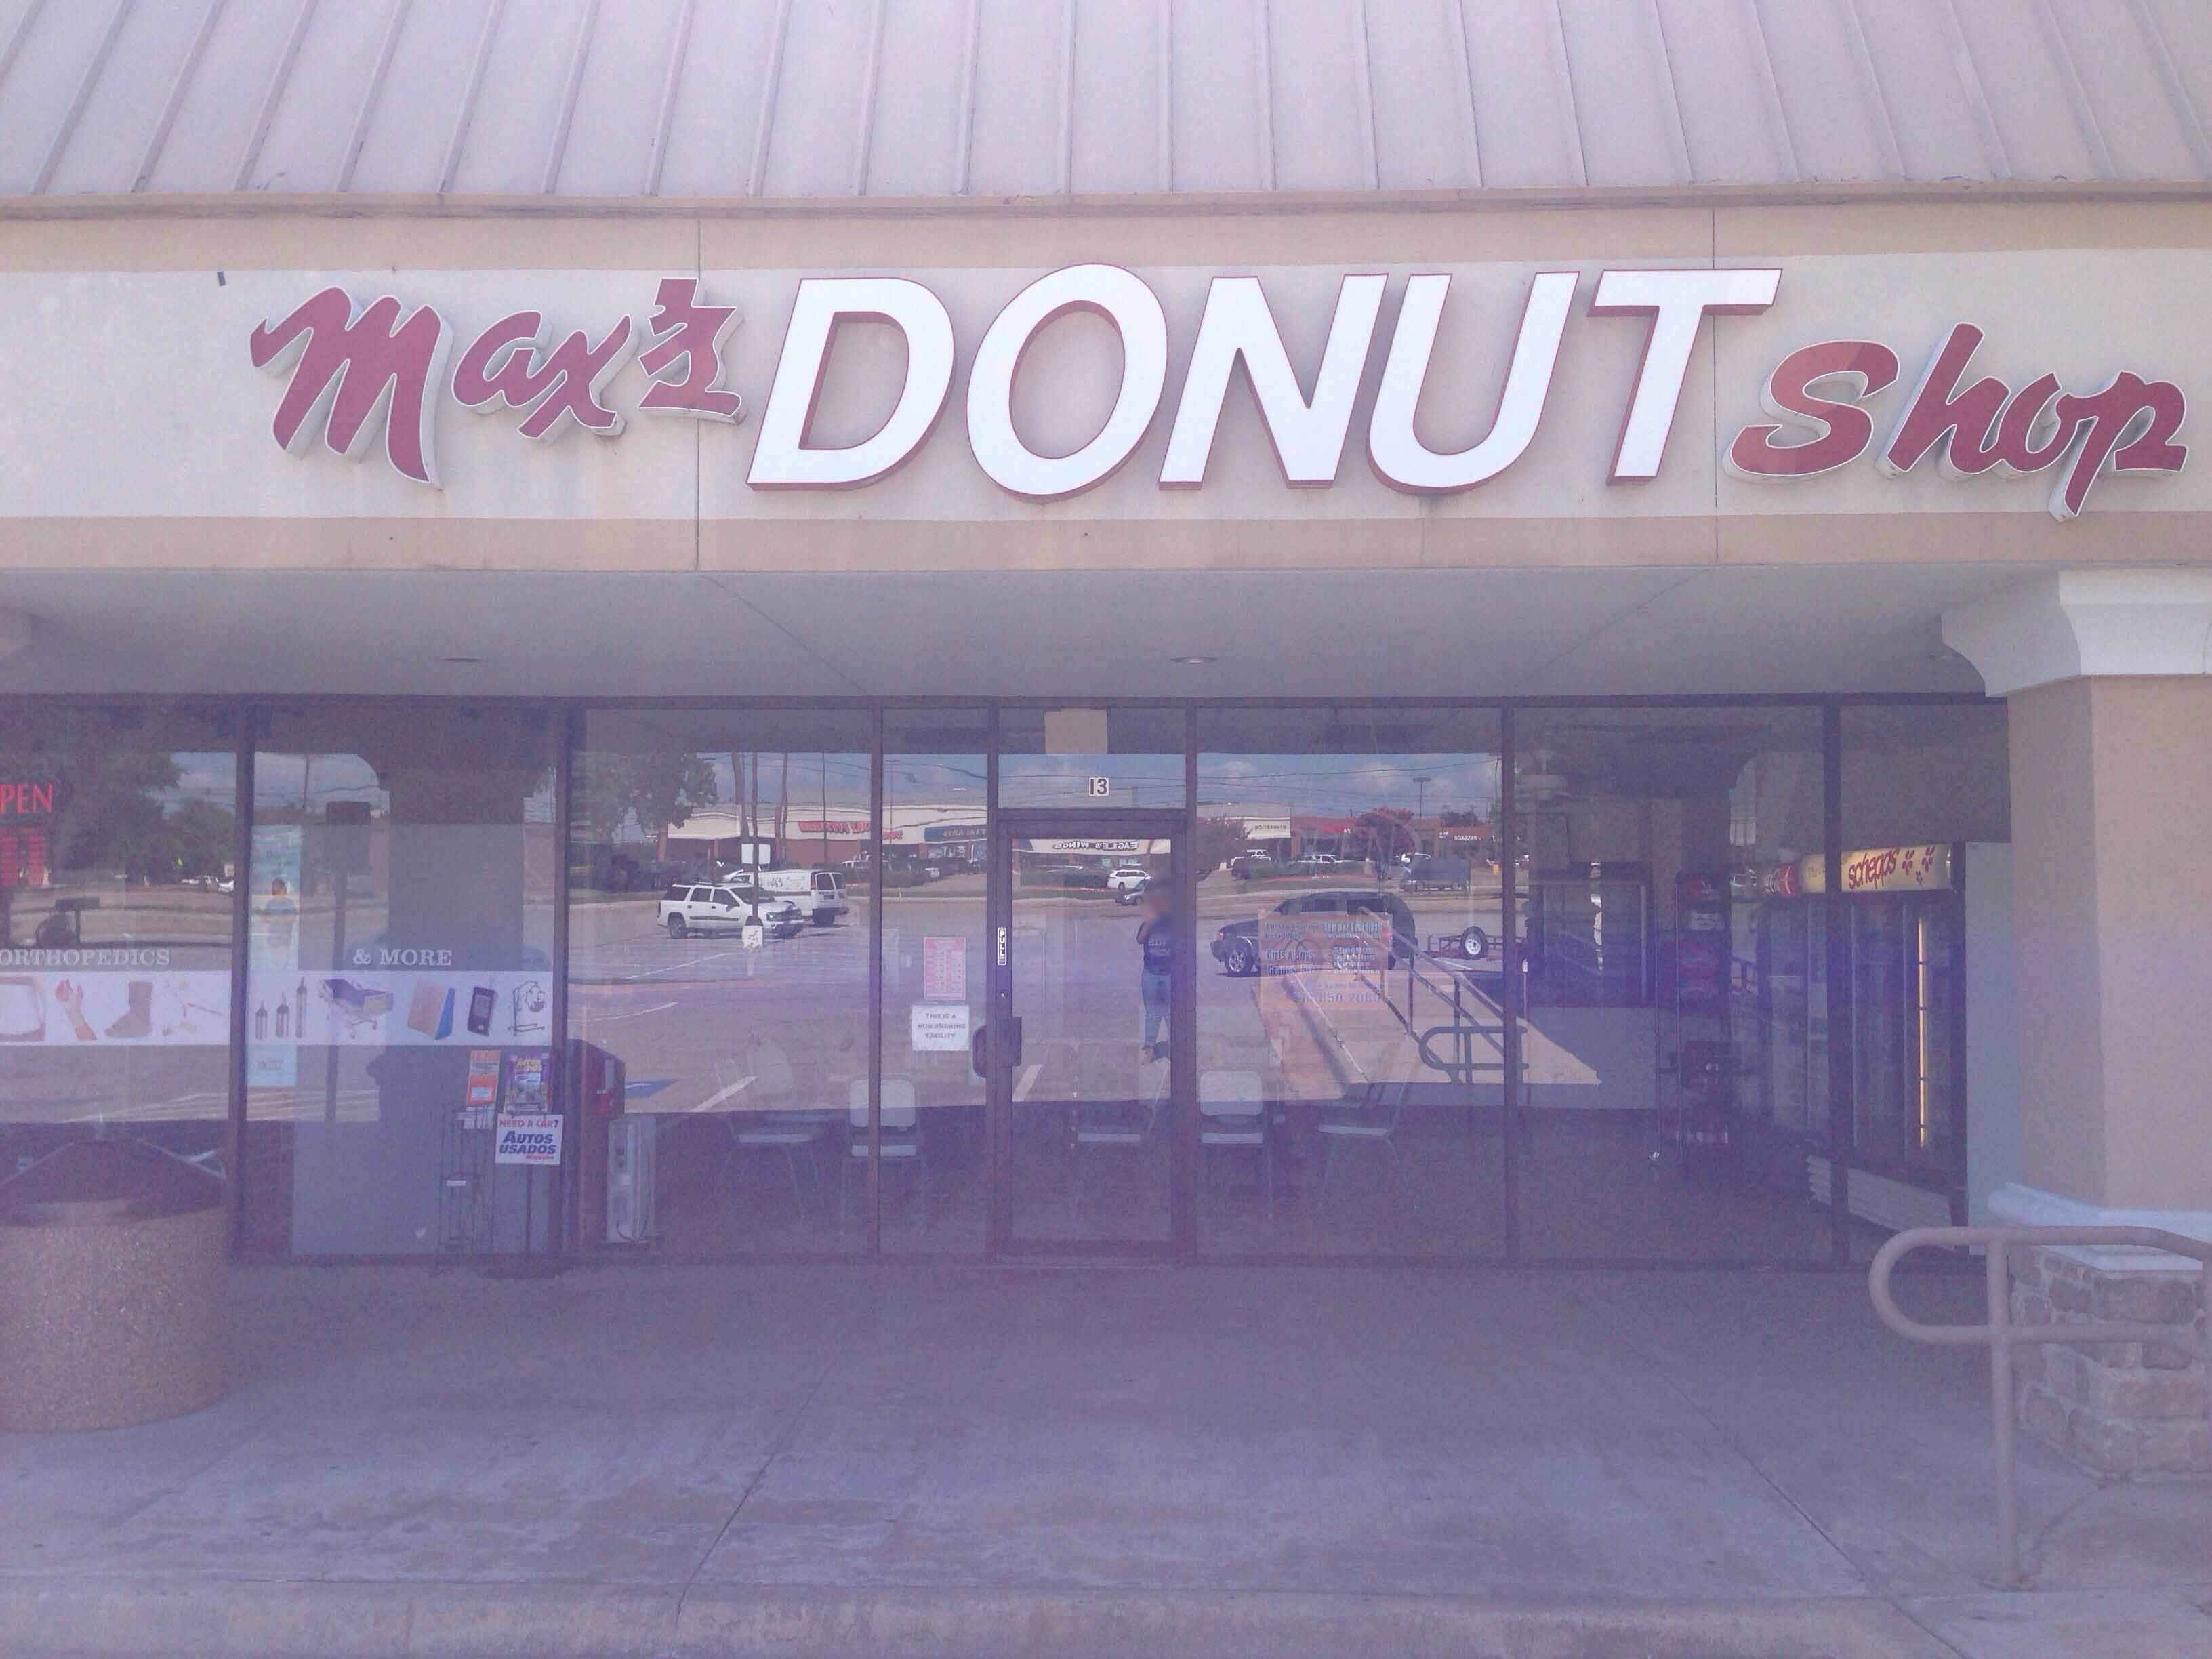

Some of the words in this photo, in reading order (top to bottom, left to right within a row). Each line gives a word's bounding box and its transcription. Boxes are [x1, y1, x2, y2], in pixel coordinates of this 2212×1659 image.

[747, 264, 1782, 500] DONUT
[1729, 322, 2190, 518] Shop
[1090, 778, 1107, 795] 13
[0, 949, 169, 966] ORTHOPEDICS
[353, 948, 371, 965] &
[380, 949, 452, 966] MORE
[499, 1120, 525, 1128] NEED
[527, 1120, 533, 1128] A
[499, 1144, 556, 1155] USADOS
